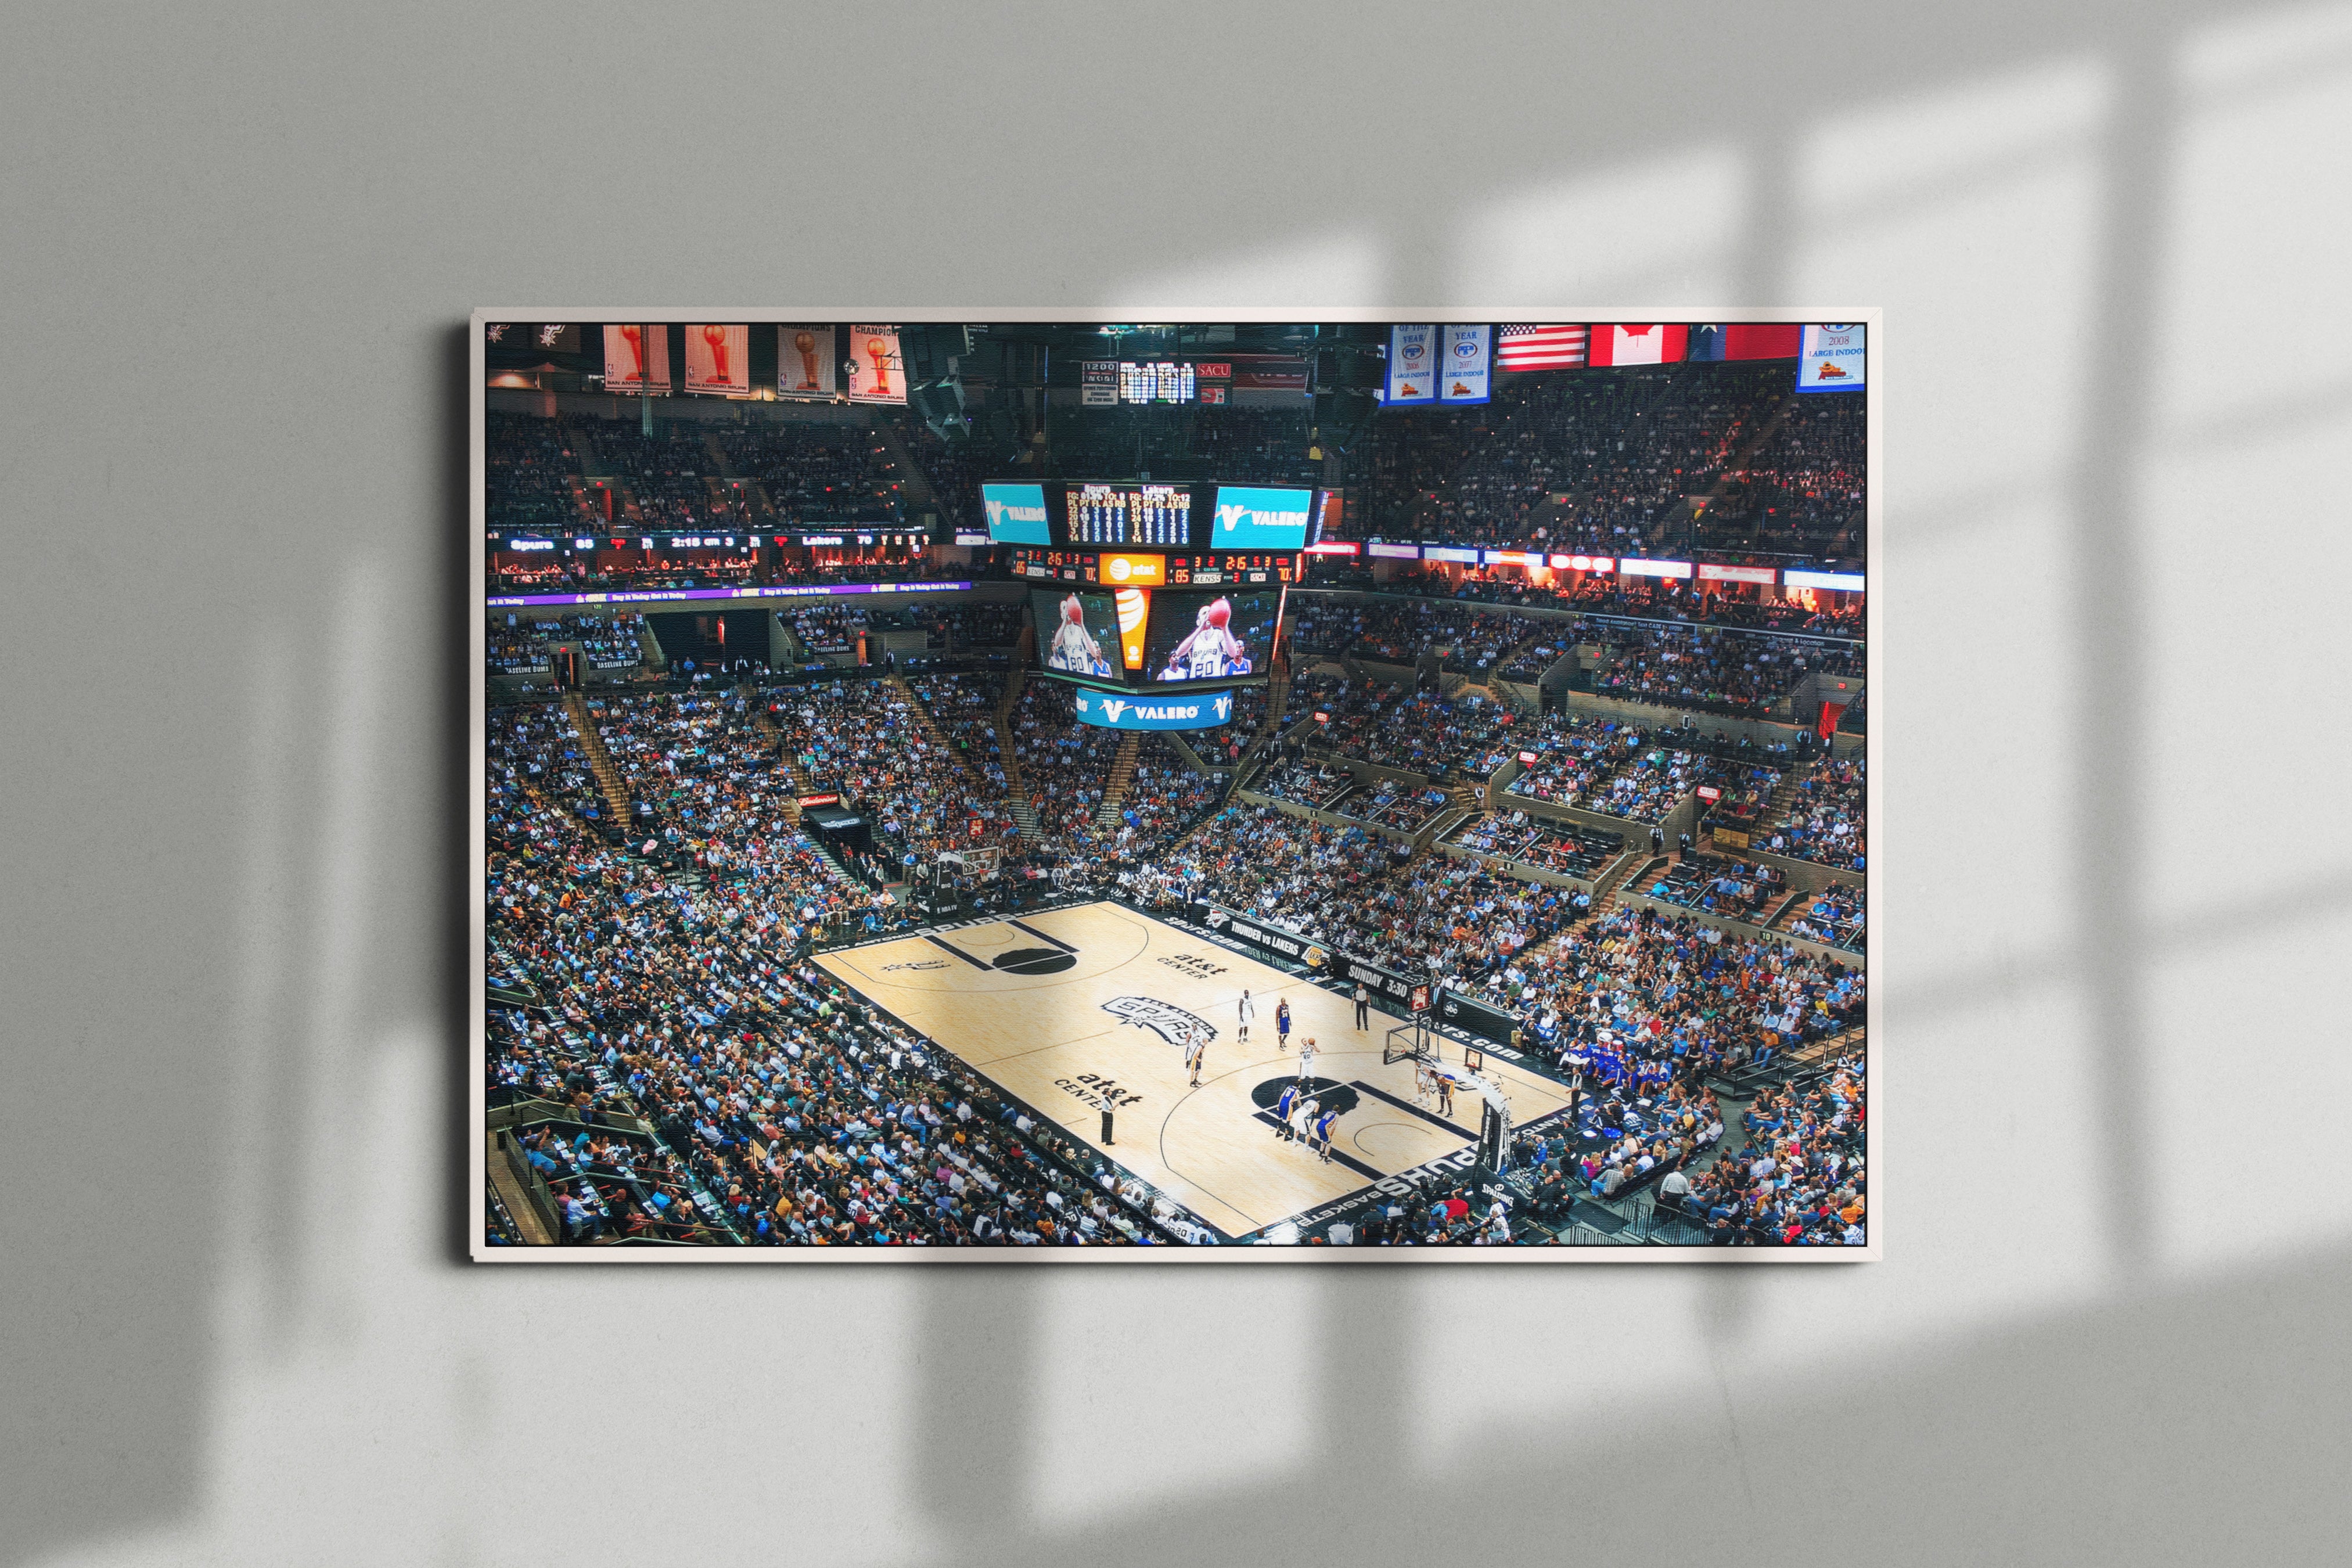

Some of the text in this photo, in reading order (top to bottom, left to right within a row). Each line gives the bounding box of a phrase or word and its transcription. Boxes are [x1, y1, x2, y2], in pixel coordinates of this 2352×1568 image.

[1404, 335, 1423, 343] YEAR
[1455, 332, 1477, 340] YEAR
[1829, 336, 1850, 346] 2008
[1200, 365, 1229, 376] SACU
[1007, 506, 1046, 522] VALERO
[1251, 510, 1309, 526] VALERO
[510, 539, 554, 552] Spurs
[672, 538, 700, 547] 2:15
[802, 535, 843, 546] Lakers
[858, 535, 872, 545] 70
[1133, 564, 1156, 575] at&t
[1195, 556, 1201, 567] 3
[1226, 556, 1246, 570] 2:15
[1265, 556, 1271, 567] 3
[1176, 569, 1189, 583] 85
[1278, 568, 1289, 581] 70
[1135, 706, 1198, 720] VALERO
[914, 913, 1016, 936] SPURS
[855, 932, 915, 947] ANTONIO
[1164, 917, 1247, 950] spurs.com
[1232, 921, 1262, 942] THUNDER
[1271, 936, 1299, 955] LAKERS
[1157, 958, 1208, 980] CENTER
[1174, 954, 1228, 975] at&t
[1348, 965, 1383, 988] SUNDAY
[1387, 979, 1408, 998] 3:30
[1434, 1023, 1524, 1060] rs.com
[1055, 1079, 1102, 1110] CENTE
[1077, 1074, 1143, 1106] at&t
[1375, 1144, 1480, 1196] PURS
[1482, 1183, 1514, 1207] SPALDING
